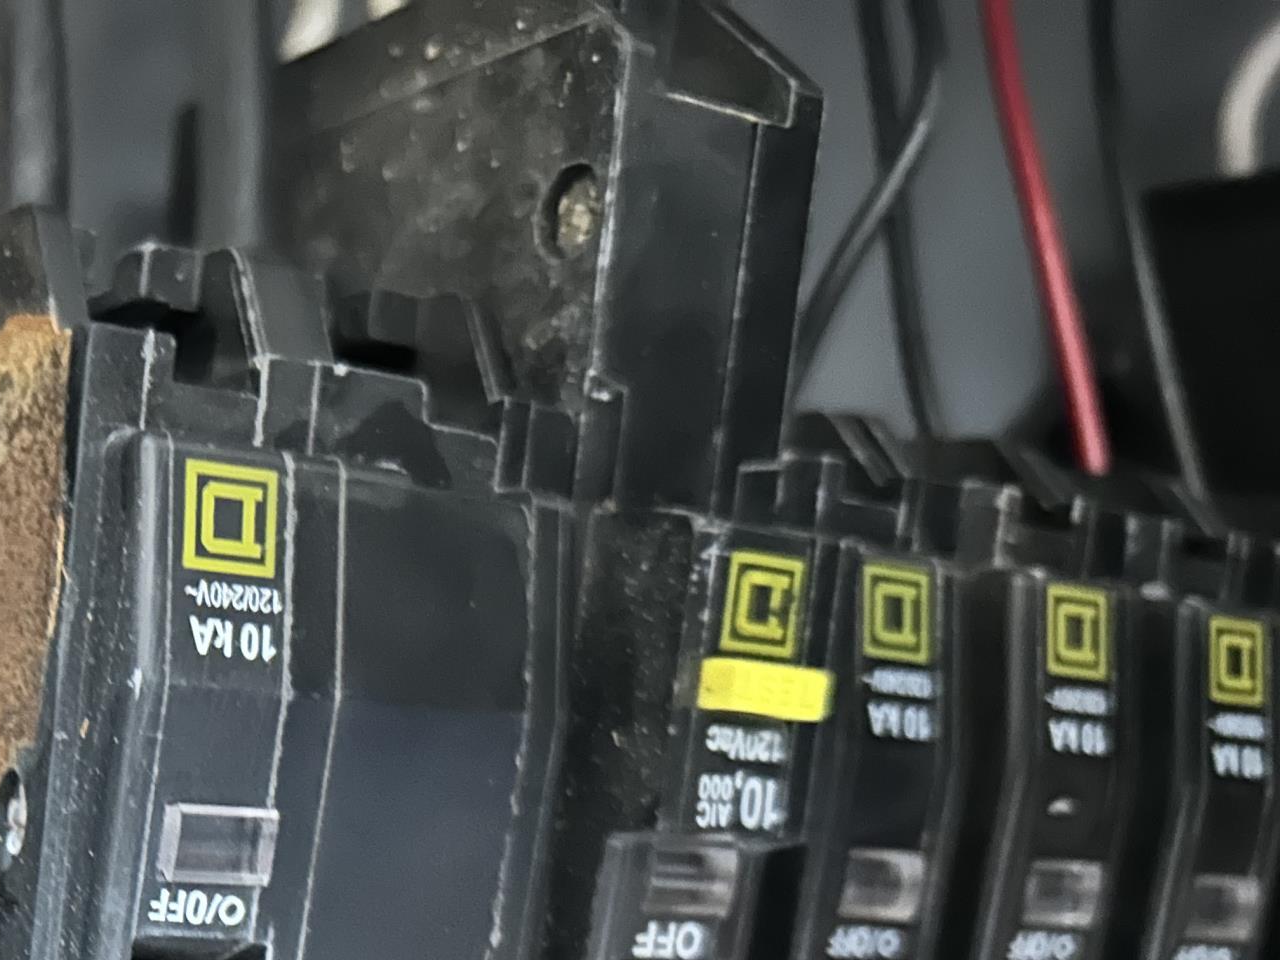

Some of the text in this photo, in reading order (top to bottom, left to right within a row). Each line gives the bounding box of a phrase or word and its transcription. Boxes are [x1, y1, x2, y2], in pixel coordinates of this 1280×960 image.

[189, 615, 277, 663] 10 kA
[904, 706, 934, 741] 10
[148, 888, 245, 927] O/OFF
[632, 921, 702, 960] OFF
